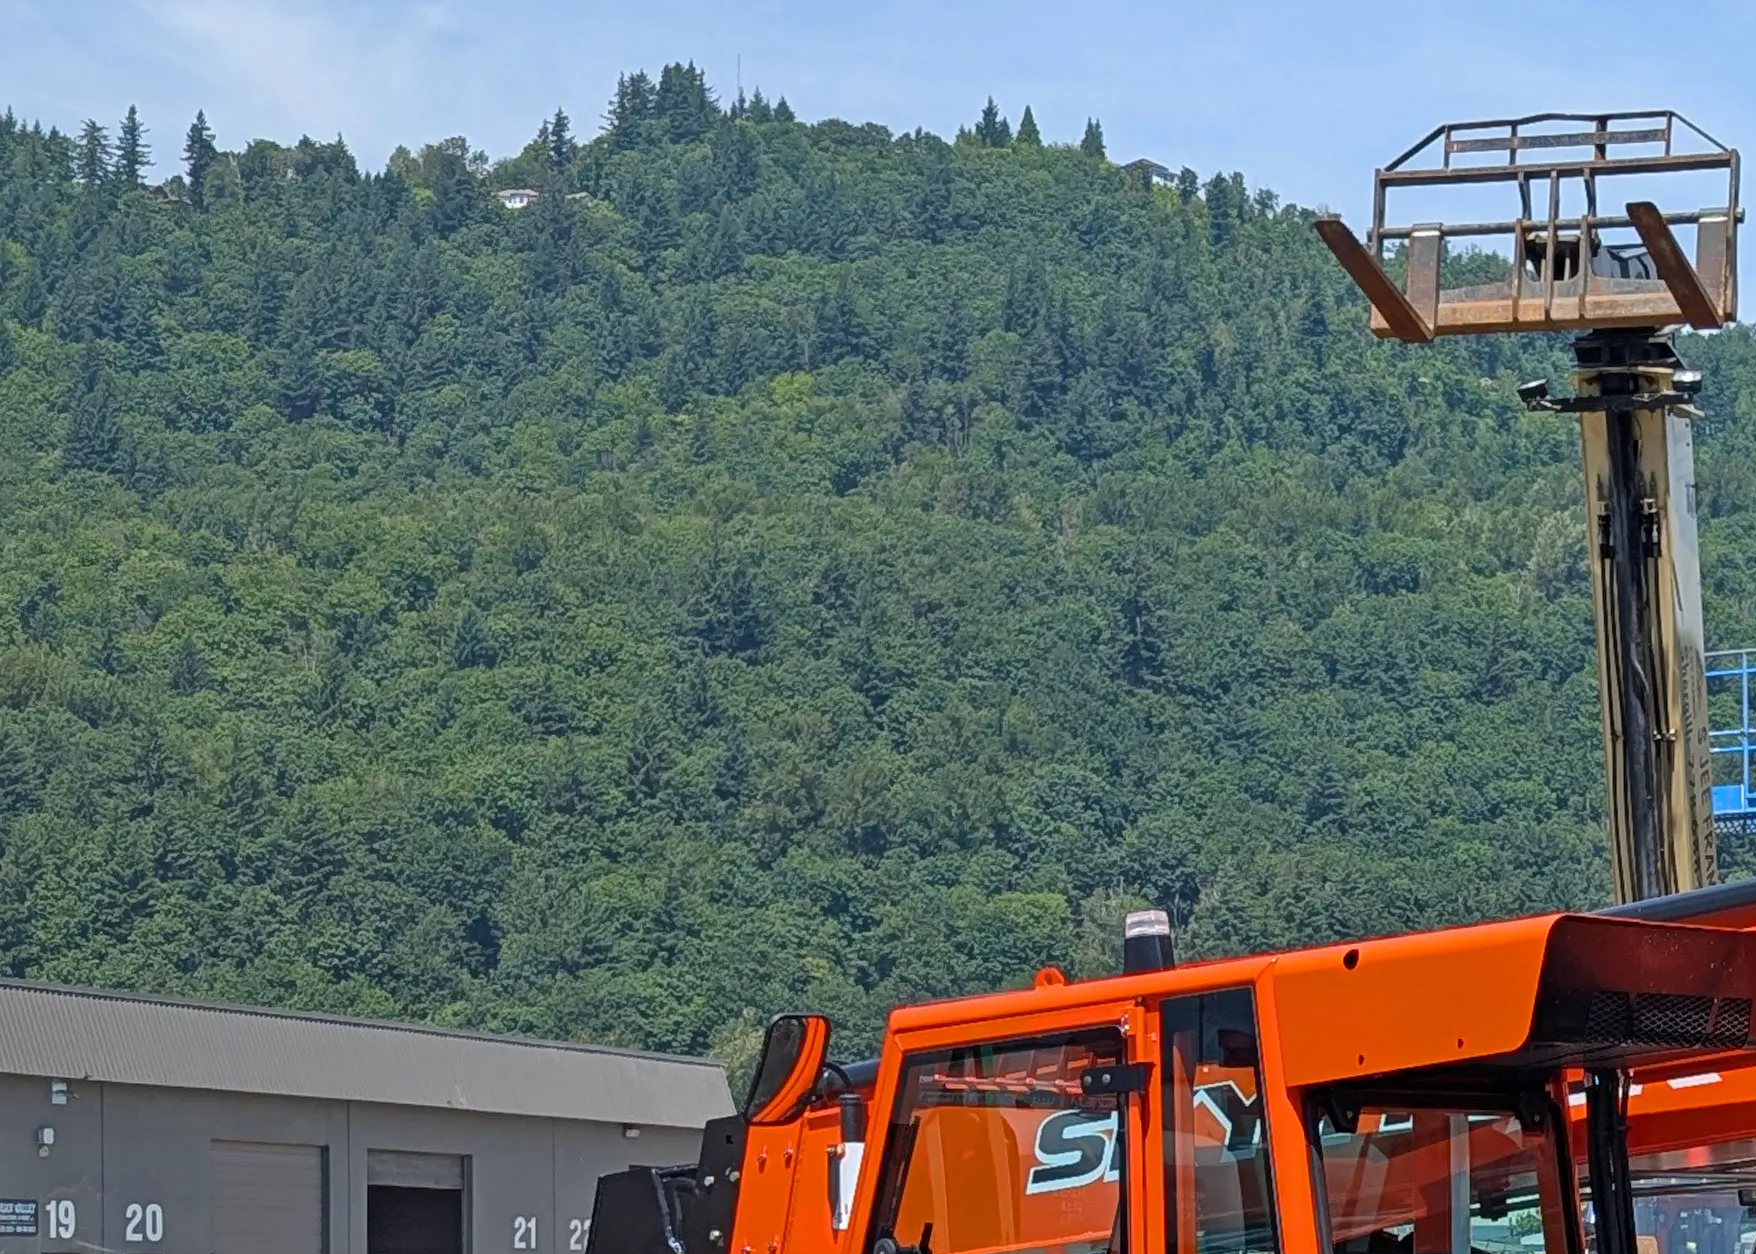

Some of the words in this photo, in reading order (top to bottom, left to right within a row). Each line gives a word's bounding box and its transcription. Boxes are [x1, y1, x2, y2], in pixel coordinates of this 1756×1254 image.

[45, 1199, 76, 1239] 19
[125, 1203, 163, 1242] 20
[514, 1216, 537, 1249] 21
